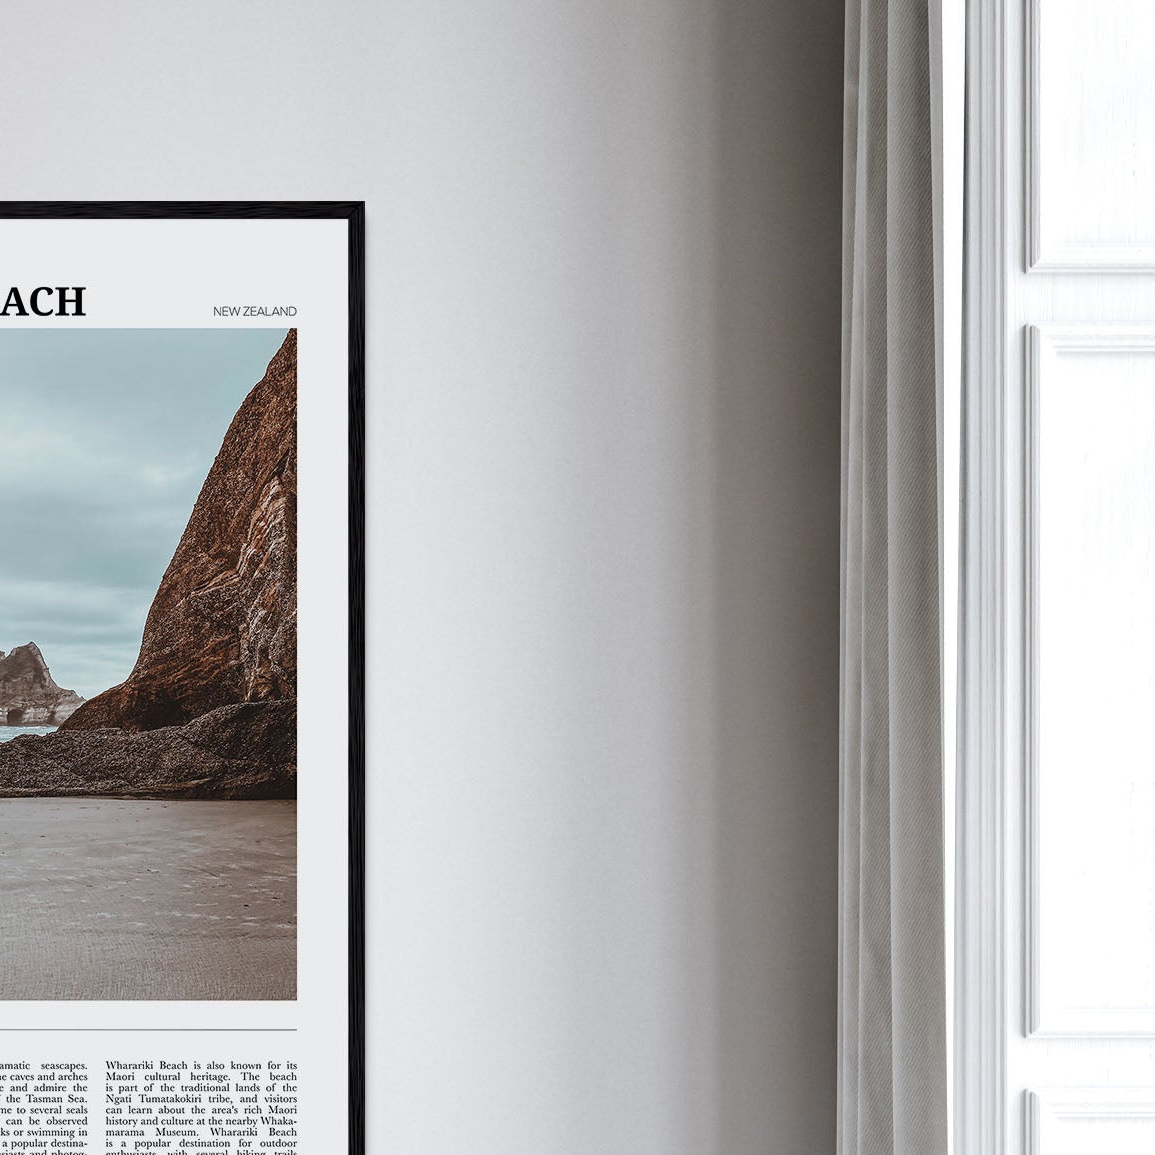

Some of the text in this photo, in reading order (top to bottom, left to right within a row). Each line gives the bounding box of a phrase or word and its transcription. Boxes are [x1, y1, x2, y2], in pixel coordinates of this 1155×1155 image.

[213, 306, 298, 317] NEW ZEALAND
[40, 1063, 88, 1072] seascapes.
[106, 1061, 298, 1070] Wharariki Beach is also known for its
[37, 1072, 56, 1081] and
[57, 1072, 89, 1081] arches
[105, 1072, 298, 1083] Maori cultural heritage. The beach
[9, 1083, 28, 1092] and
[33, 1083, 68, 1092] admire
[72, 1083, 88, 1092] the
[5, 1094, 22, 1103] the
[26, 1094, 64, 1103] Tasman
[67, 1094, 88, 1103] Sea.
[105, 1094, 298, 1105] Ngati Tumatakokiri tribe, and visitors
[28, 1116, 41, 1125] be
[45, 1116, 89, 1125] observed
[105, 1116, 298, 1127] history and culture at the nearby Whaka-
[26, 1127, 76, 1138] swimming
[77, 1127, 88, 1136] in
[155, 1127, 200, 1136] Museum.
[210, 1127, 258, 1136] Wharariki
[268, 1127, 298, 1136] Beach
[105, 1138, 114, 1147] is
[134, 1138, 172, 1149] popular
[178, 1138, 231, 1147] destination
[238, 1138, 253, 1147] for
[259, 1138, 298, 1147] outdoor
